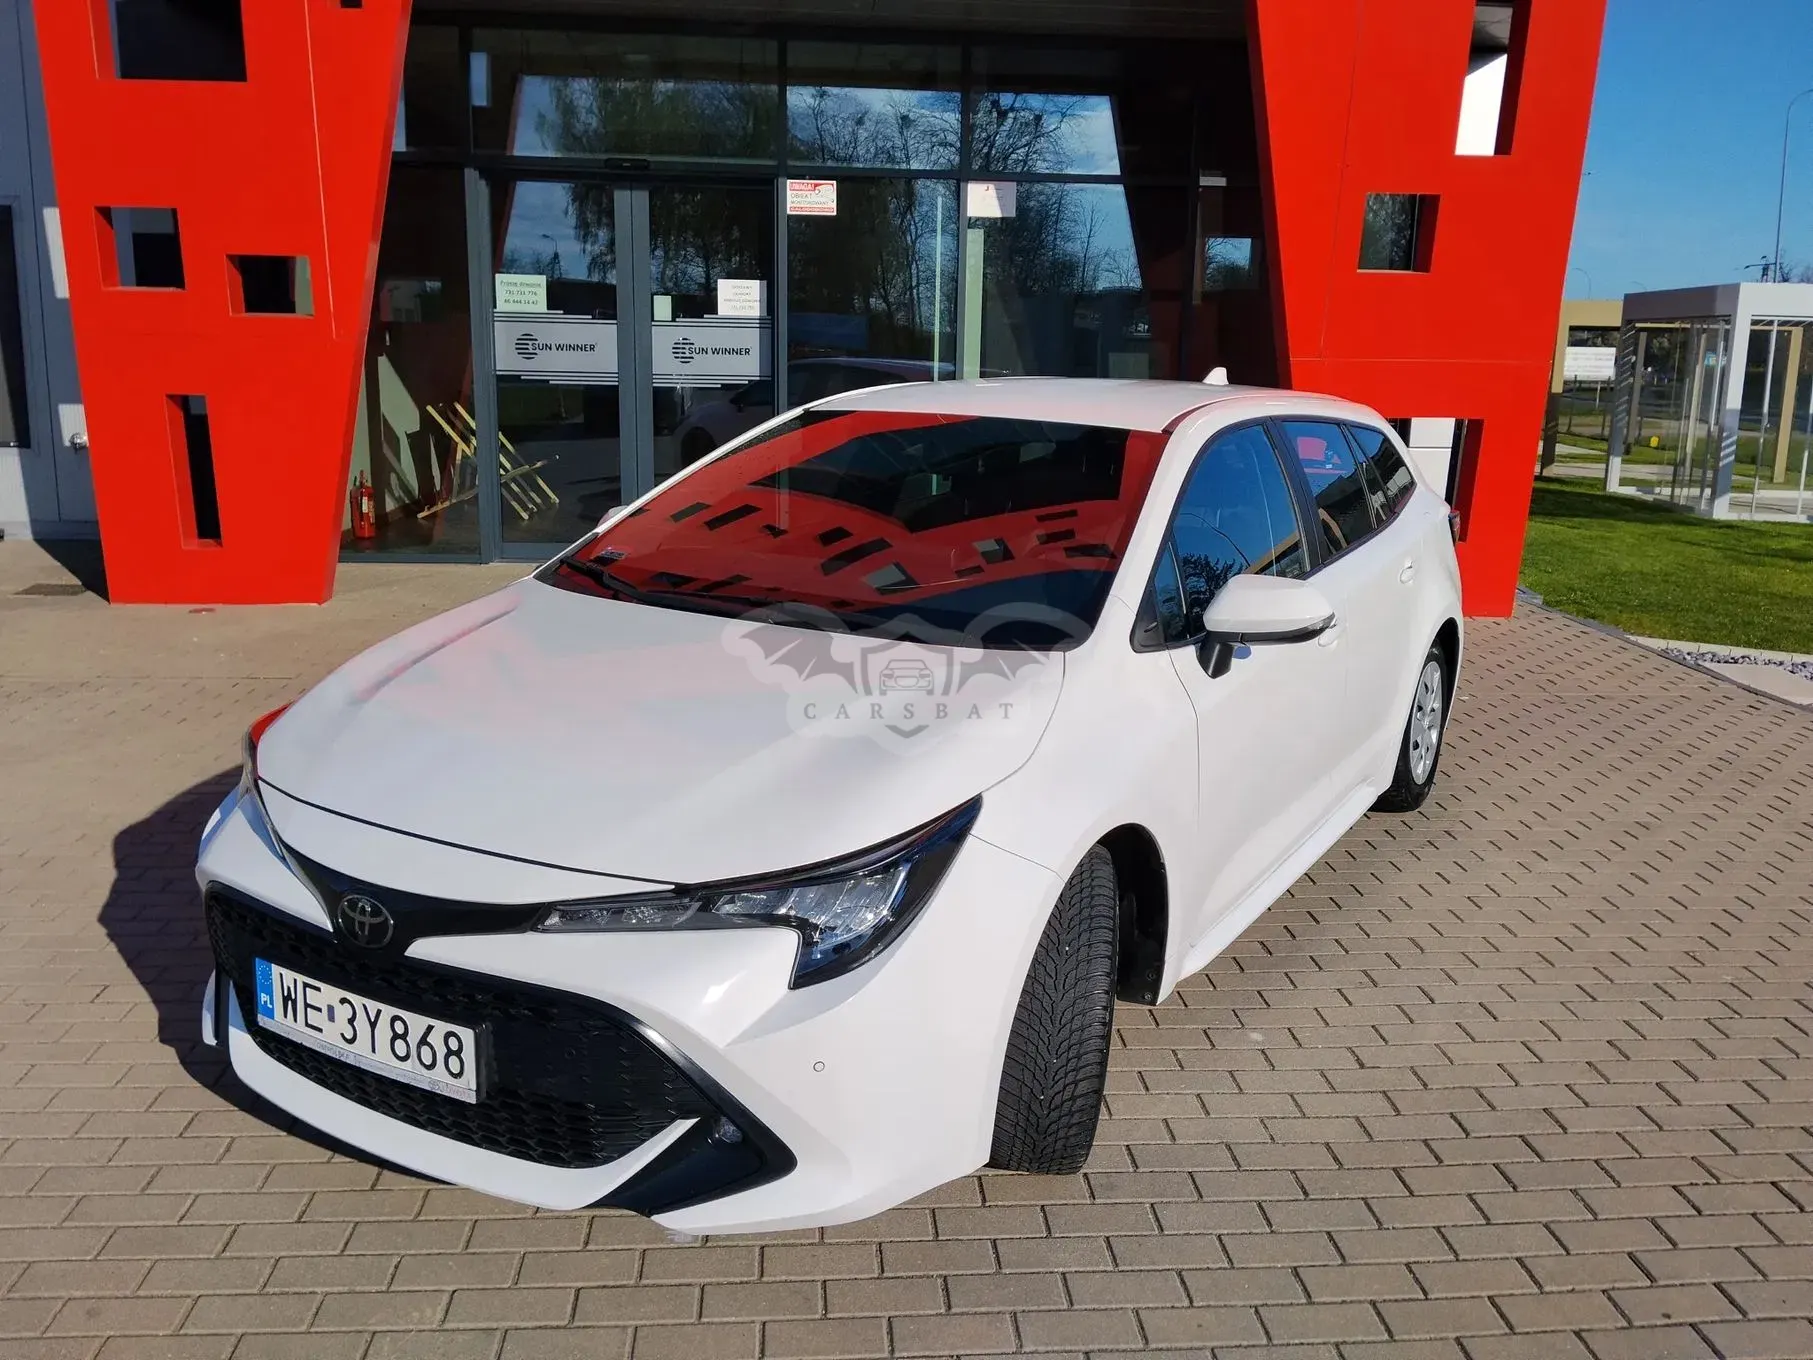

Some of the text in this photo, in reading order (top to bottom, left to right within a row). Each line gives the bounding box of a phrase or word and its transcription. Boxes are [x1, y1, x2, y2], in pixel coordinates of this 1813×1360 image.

[531, 342, 596, 353] SUN WINNER
[687, 346, 751, 356] SUN WINNER
[260, 992, 273, 1009] PL
[279, 971, 465, 1080] WE 3Y868
